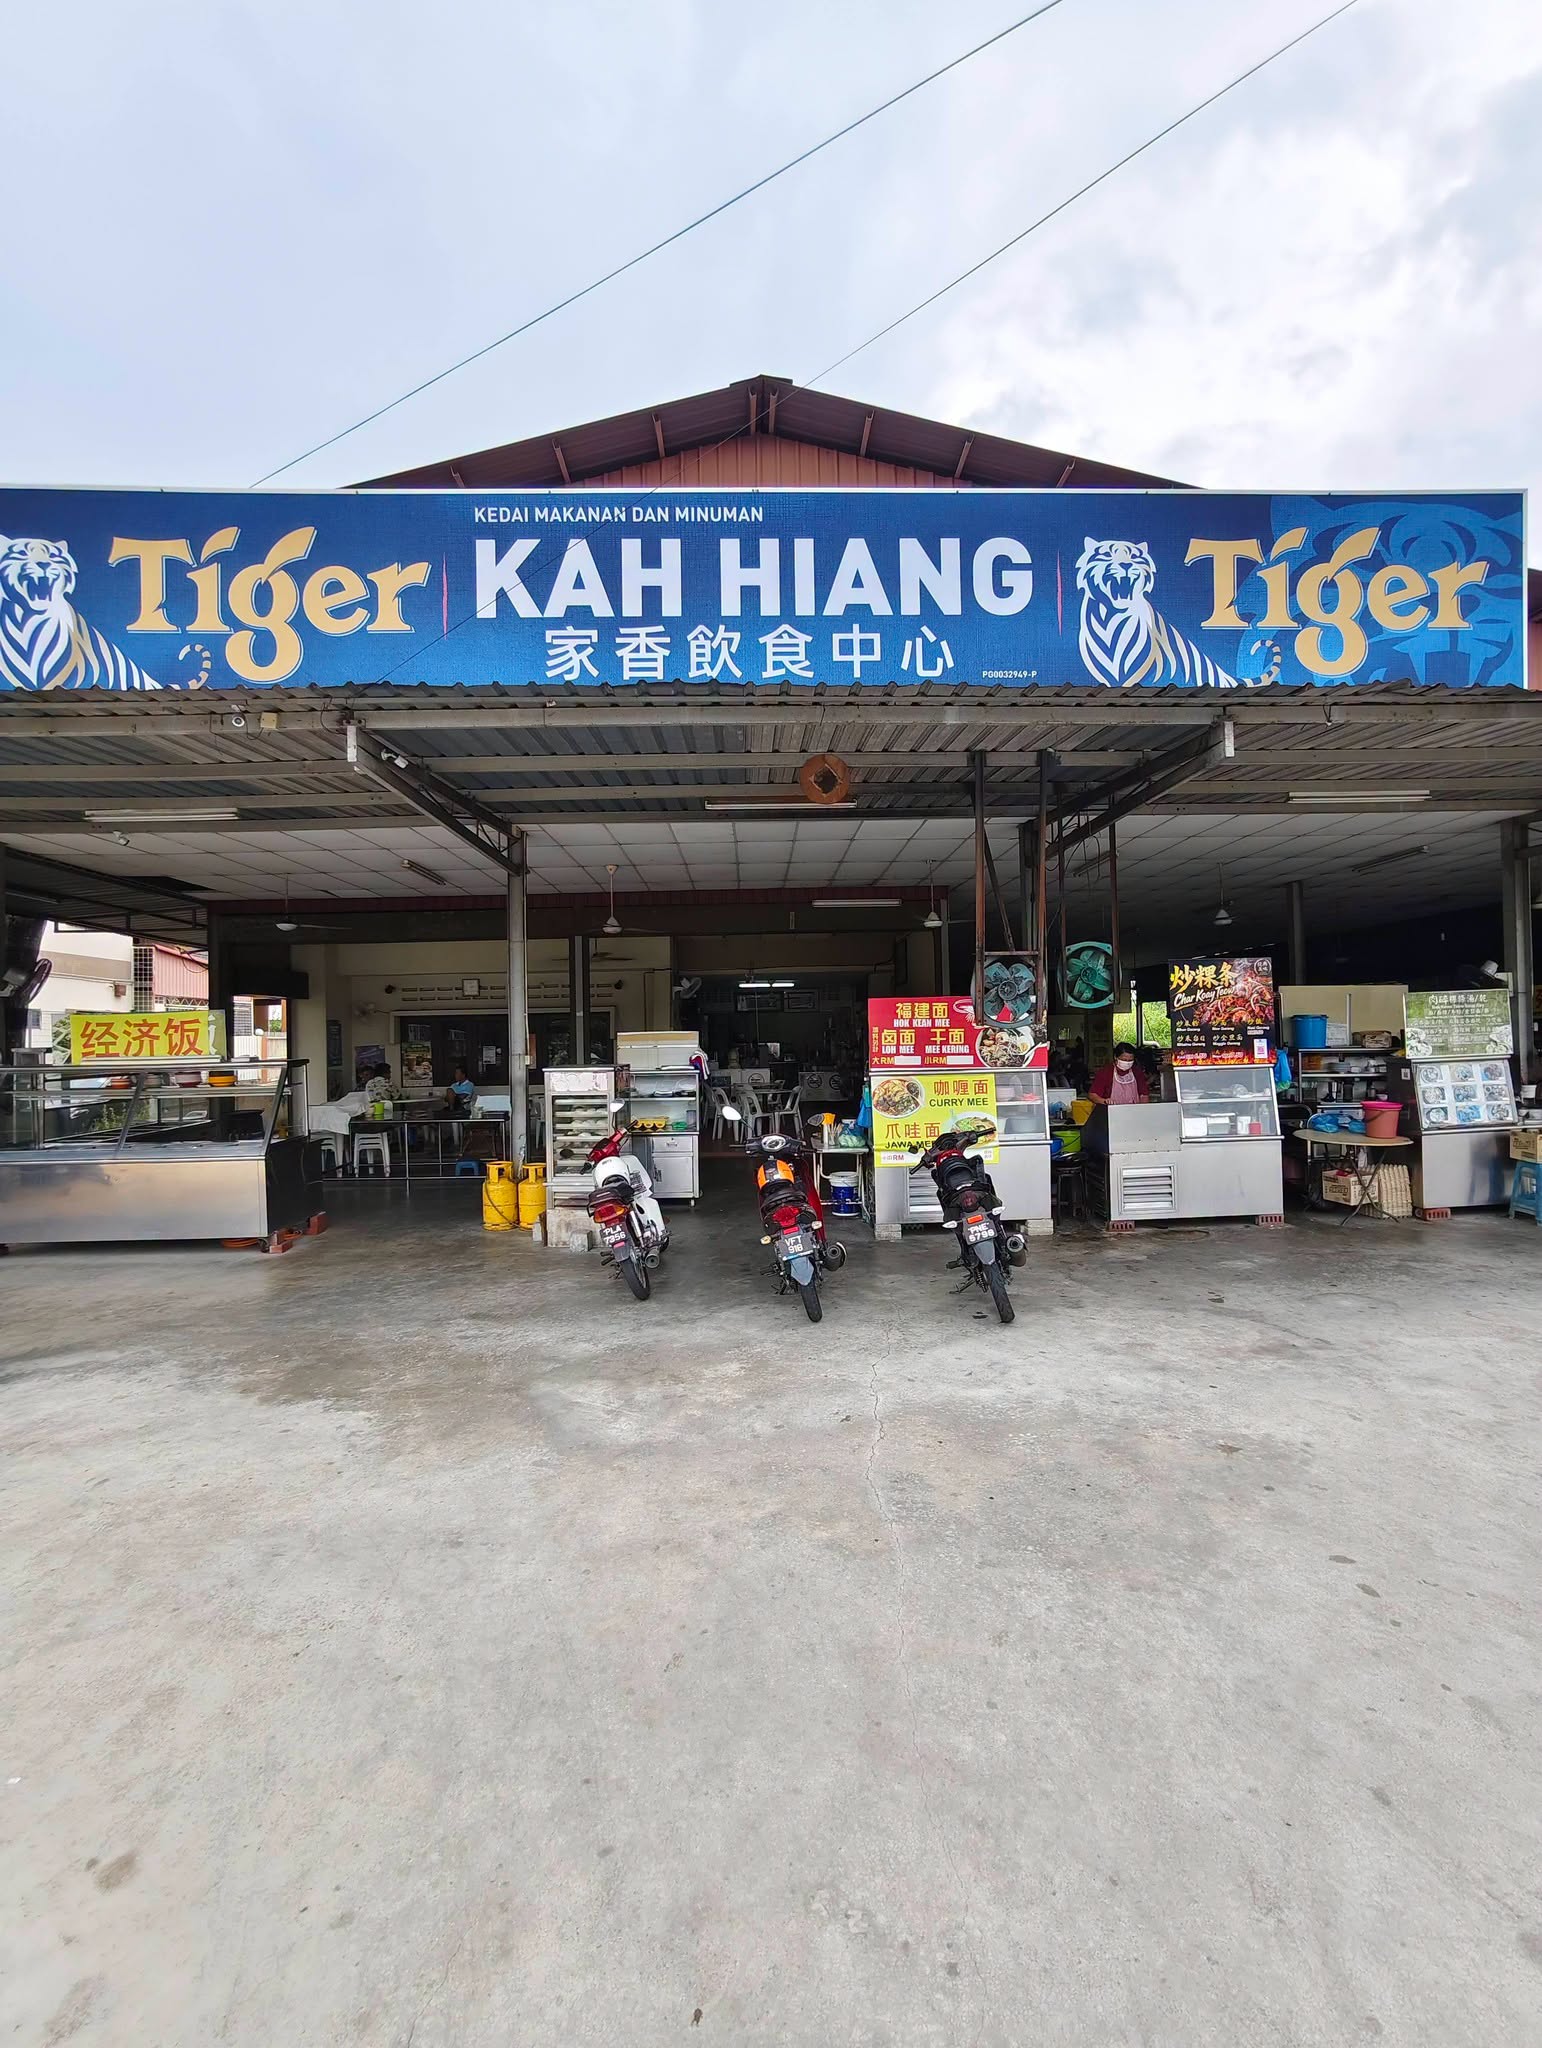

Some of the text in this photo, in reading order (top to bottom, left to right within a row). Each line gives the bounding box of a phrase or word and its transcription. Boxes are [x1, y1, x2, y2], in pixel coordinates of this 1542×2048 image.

[474, 506, 763, 523] KEDAI MAKANAN DAN MINUMAN
[475, 537, 1033, 618] KAH HIANG
[108, 526, 432, 684] Tiger
[1184, 527, 1490, 678] Tiger
[545, 624, 954, 681] 家香飲食中心
[982, 670, 1038, 679] PG0032949-P
[1173, 992, 1196, 1007] Char
[895, 1002, 949, 1019] 福建面
[893, 1018, 951, 1028] HOK KEAN MEE
[80, 1018, 204, 1057] 经济饭
[881, 1029, 916, 1046] 卤面
[929, 1028, 965, 1045] 干面
[882, 1045, 915, 1054] LOH MEE
[925, 1045, 970, 1053] MEE KERING
[933, 1079, 988, 1096] 咖喱面
[929, 1097, 989, 1107] CURRY MEE
[885, 1122, 941, 1139] 爪哇面
[603, 1231, 626, 1244] 7356
[784, 1235, 802, 1246] VFT
[788, 1243, 803, 1254] 918
